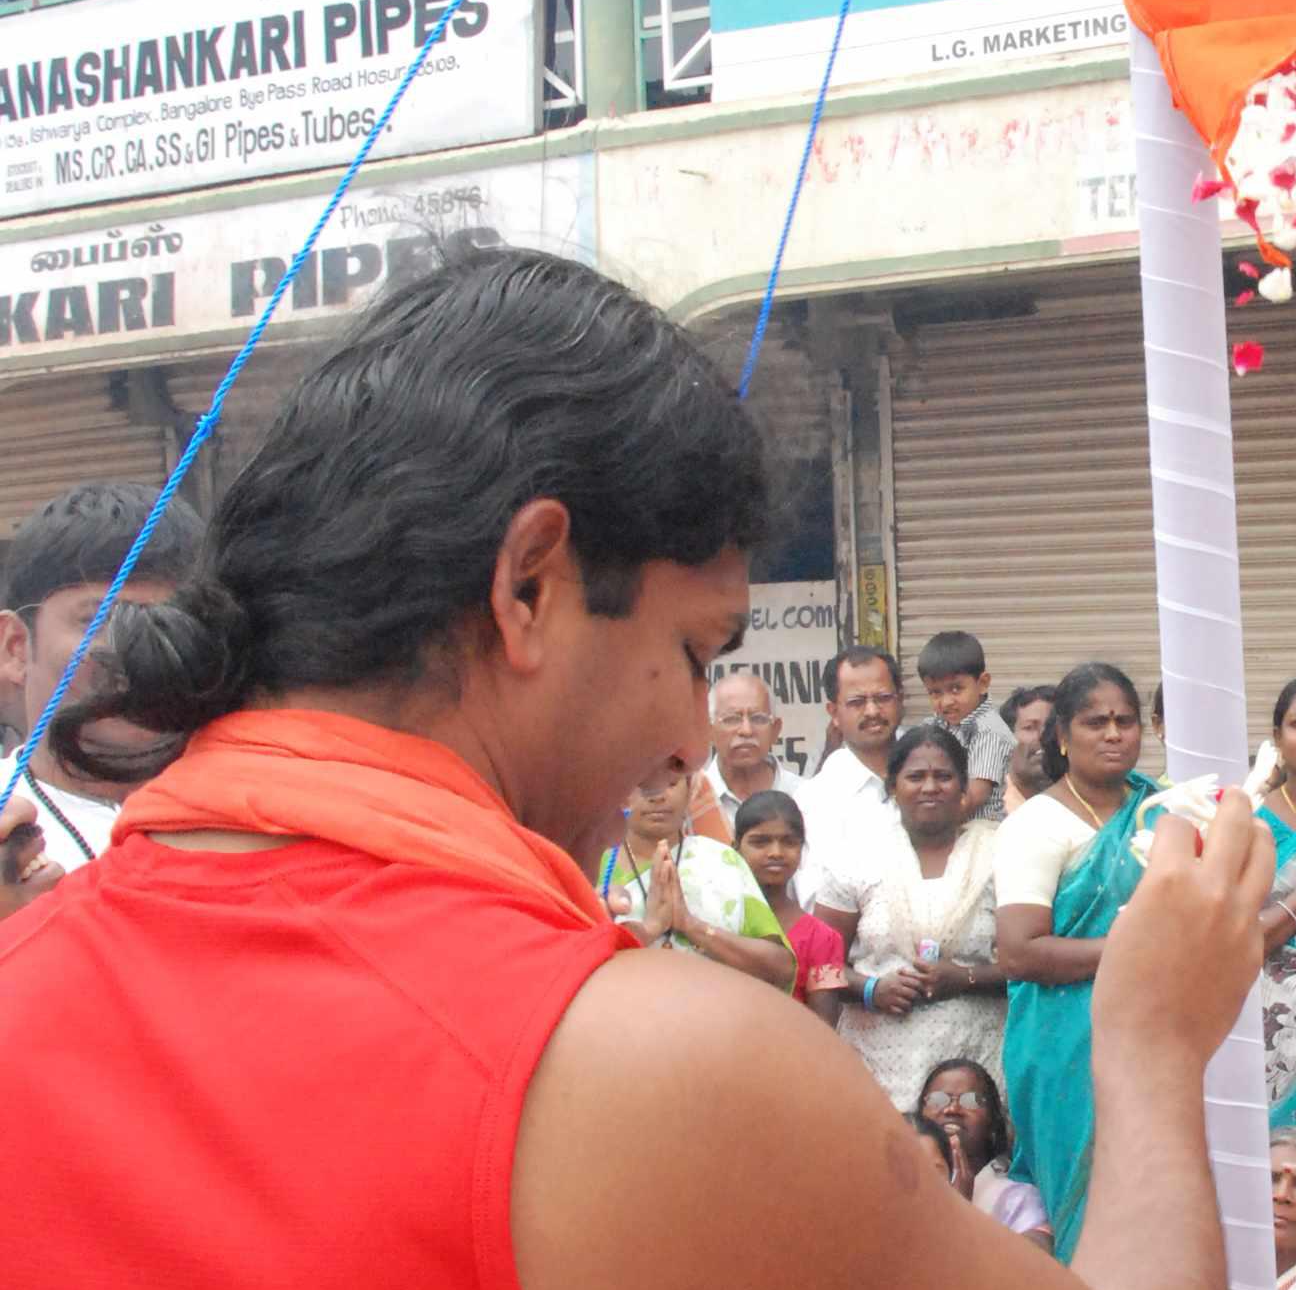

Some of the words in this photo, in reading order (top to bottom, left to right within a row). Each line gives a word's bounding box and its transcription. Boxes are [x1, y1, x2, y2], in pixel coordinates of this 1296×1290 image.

[930, 32, 976, 64] L.G.
[982, 14, 1128, 55] MARKETING
[0, 9, 307, 122] ANASHANKARI
[161, 94, 233, 122] Bangalore
[239, 89, 265, 110] Bye
[267, 81, 306, 100] Pass
[312, 72, 353, 93] Road
[225, 119, 285, 163] Pipes
[0, 271, 176, 347] KARI
